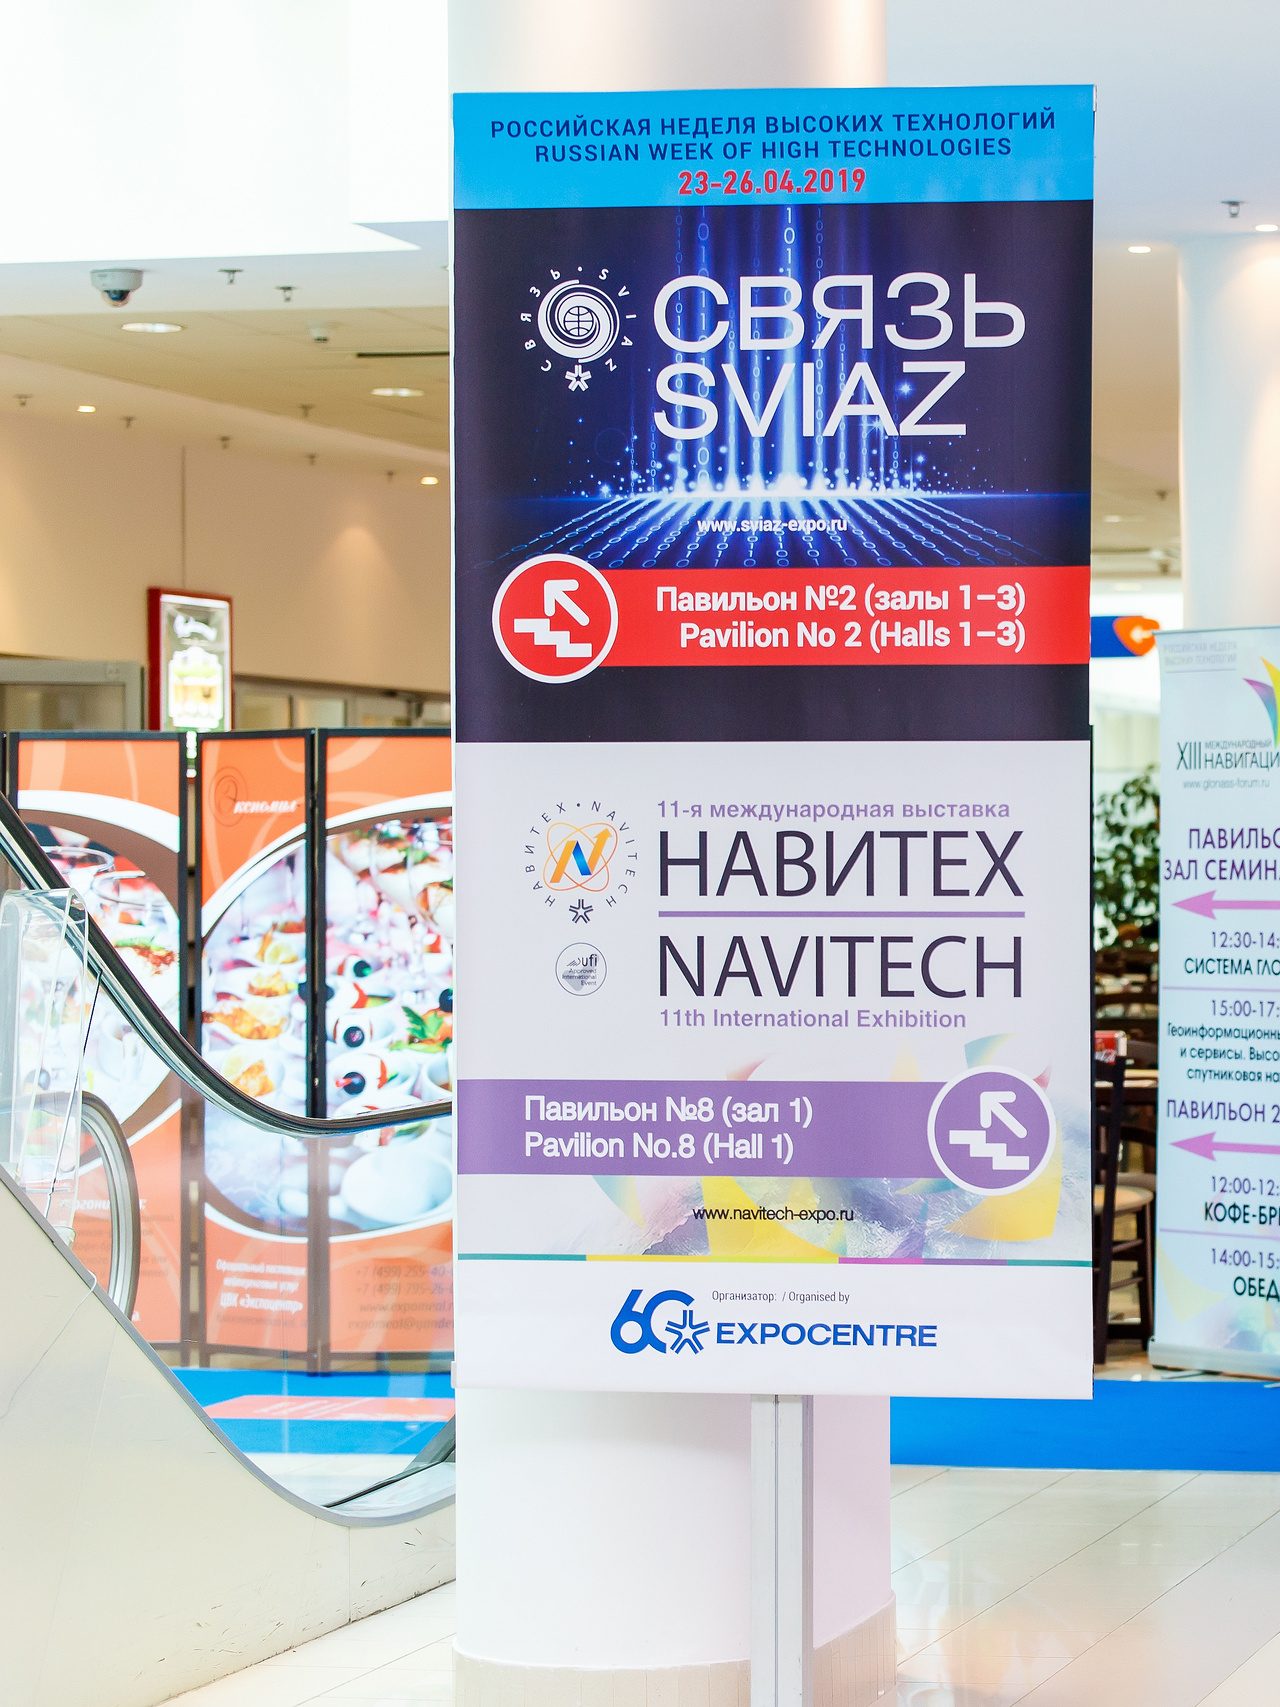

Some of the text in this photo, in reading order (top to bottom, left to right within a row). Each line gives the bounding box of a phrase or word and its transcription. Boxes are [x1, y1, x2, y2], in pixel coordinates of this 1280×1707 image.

[490, 106, 1057, 139] РОССИЙСКАЯ НЕДЕЛЯ ВЫСОКИХ ТЕХНОЛОГИЙ
[535, 136, 1012, 163] RUSSIAN WEEK OF HIGH TECHNOLOGIES
[678, 167, 867, 196] 23-26.04.2019
[654, 272, 1025, 353] СВЯЗЬ
[654, 360, 967, 440] SVIAZ
[696, 515, 848, 535] www.sviaz-expo.ru
[656, 584, 797, 613] Павильон
[863, 583, 949, 616] (залы
[679, 621, 788, 649] Pavilion
[796, 621, 835, 648] No
[844, 621, 862, 647] 2
[869, 619, 951, 653] (Halls
[657, 800, 1010, 823] 11-я международная выставка
[658, 830, 1025, 897] НАВИТЕХ
[1164, 859, 1198, 880] ЗАЛ
[582, 954, 597, 966] ufi
[658, 935, 1023, 999] NAVITECH
[1184, 958, 1253, 975] СИСТЕМА
[659, 1008, 967, 1029] 11th International Exhibition
[1180, 1048, 1187, 1058] и
[1190, 1049, 1246, 1061] сервисы.
[1187, 1067, 1262, 1082] спутниковая
[525, 1095, 657, 1122] Павильон
[722, 1096, 780, 1128] (зал
[792, 1096, 813, 1128] 1)
[1167, 1099, 1265, 1123] ПАВИЛЬОН
[525, 1132, 794, 1164] Pavilion No.8 (Hall 1)
[693, 1205, 855, 1225] www.navitech-expo.ru
[712, 1290, 777, 1303] Организатор:
[789, 1291, 836, 1303] Organised
[838, 1291, 850, 1304] by
[1233, 1276, 1280, 1302] ОБЕД
[717, 1322, 937, 1347] EXPOCENTRE
